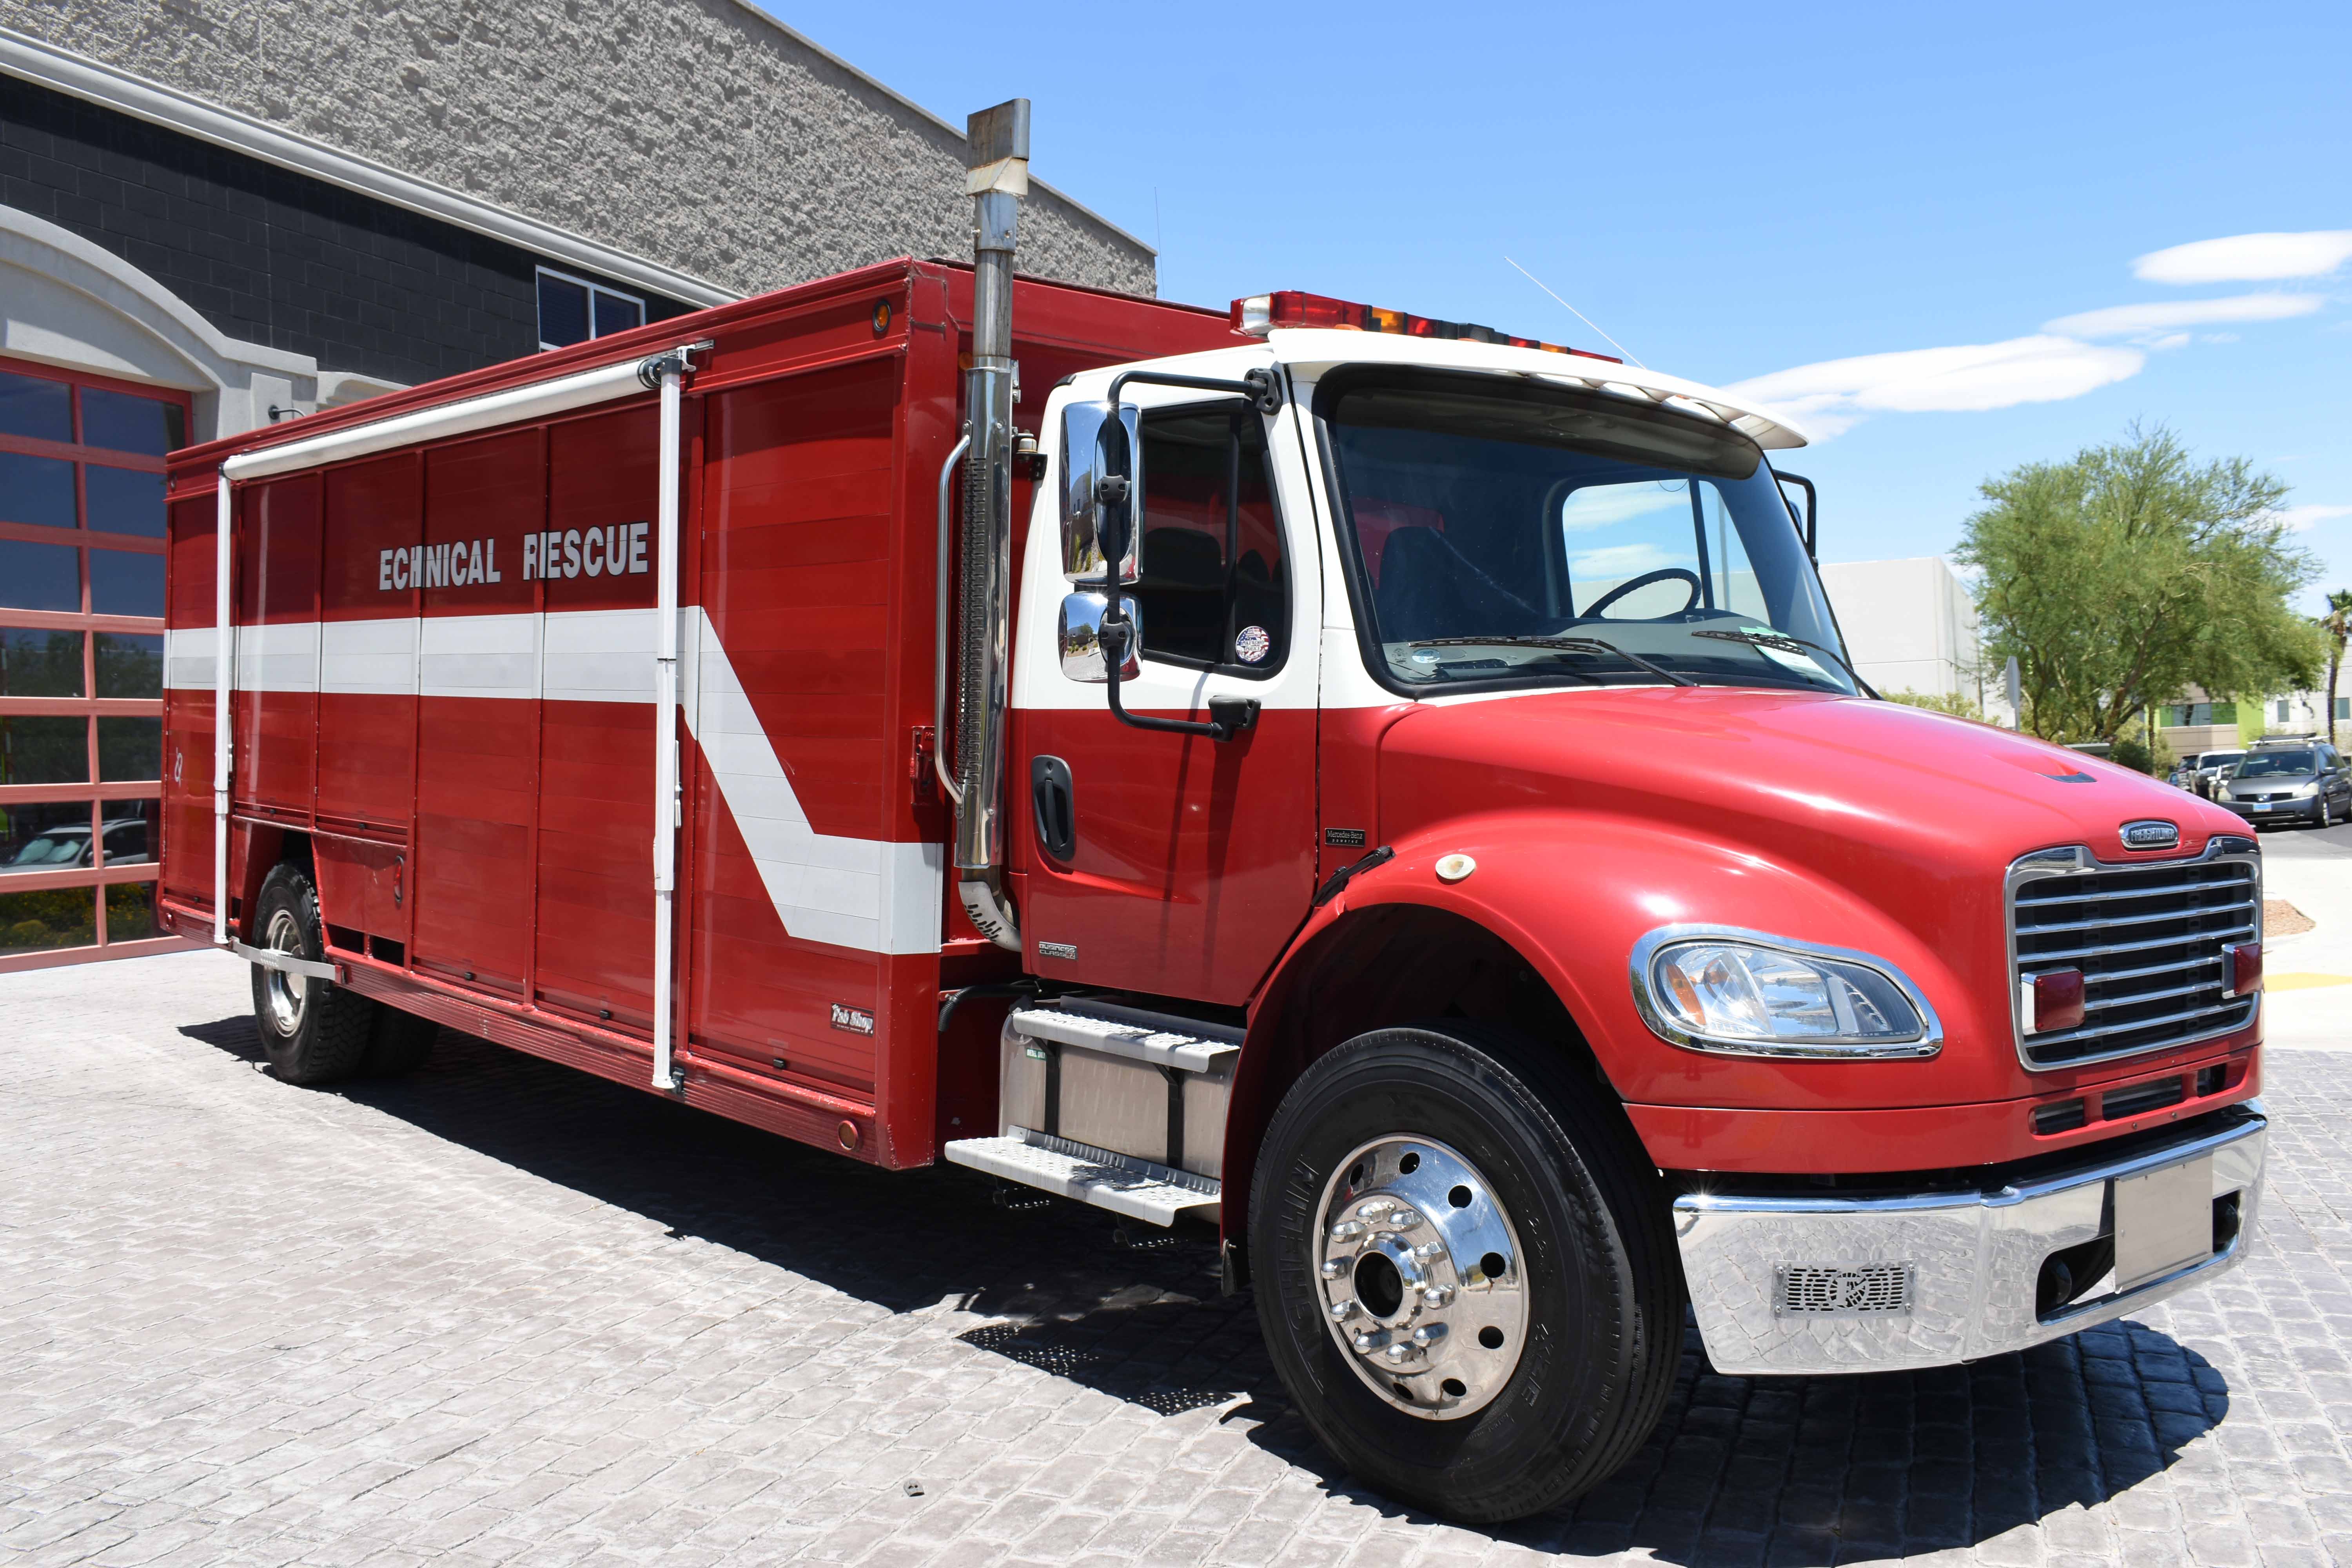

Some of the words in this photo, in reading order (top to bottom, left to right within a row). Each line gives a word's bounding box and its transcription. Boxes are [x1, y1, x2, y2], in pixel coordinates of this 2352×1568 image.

[1327, 830, 1363, 839] Mercedes-Benz
[1039, 944, 1075, 953] BUSINESS
[832, 1008, 849, 1024] Fab
[1278, 1154, 1325, 1396] ICHELIN
